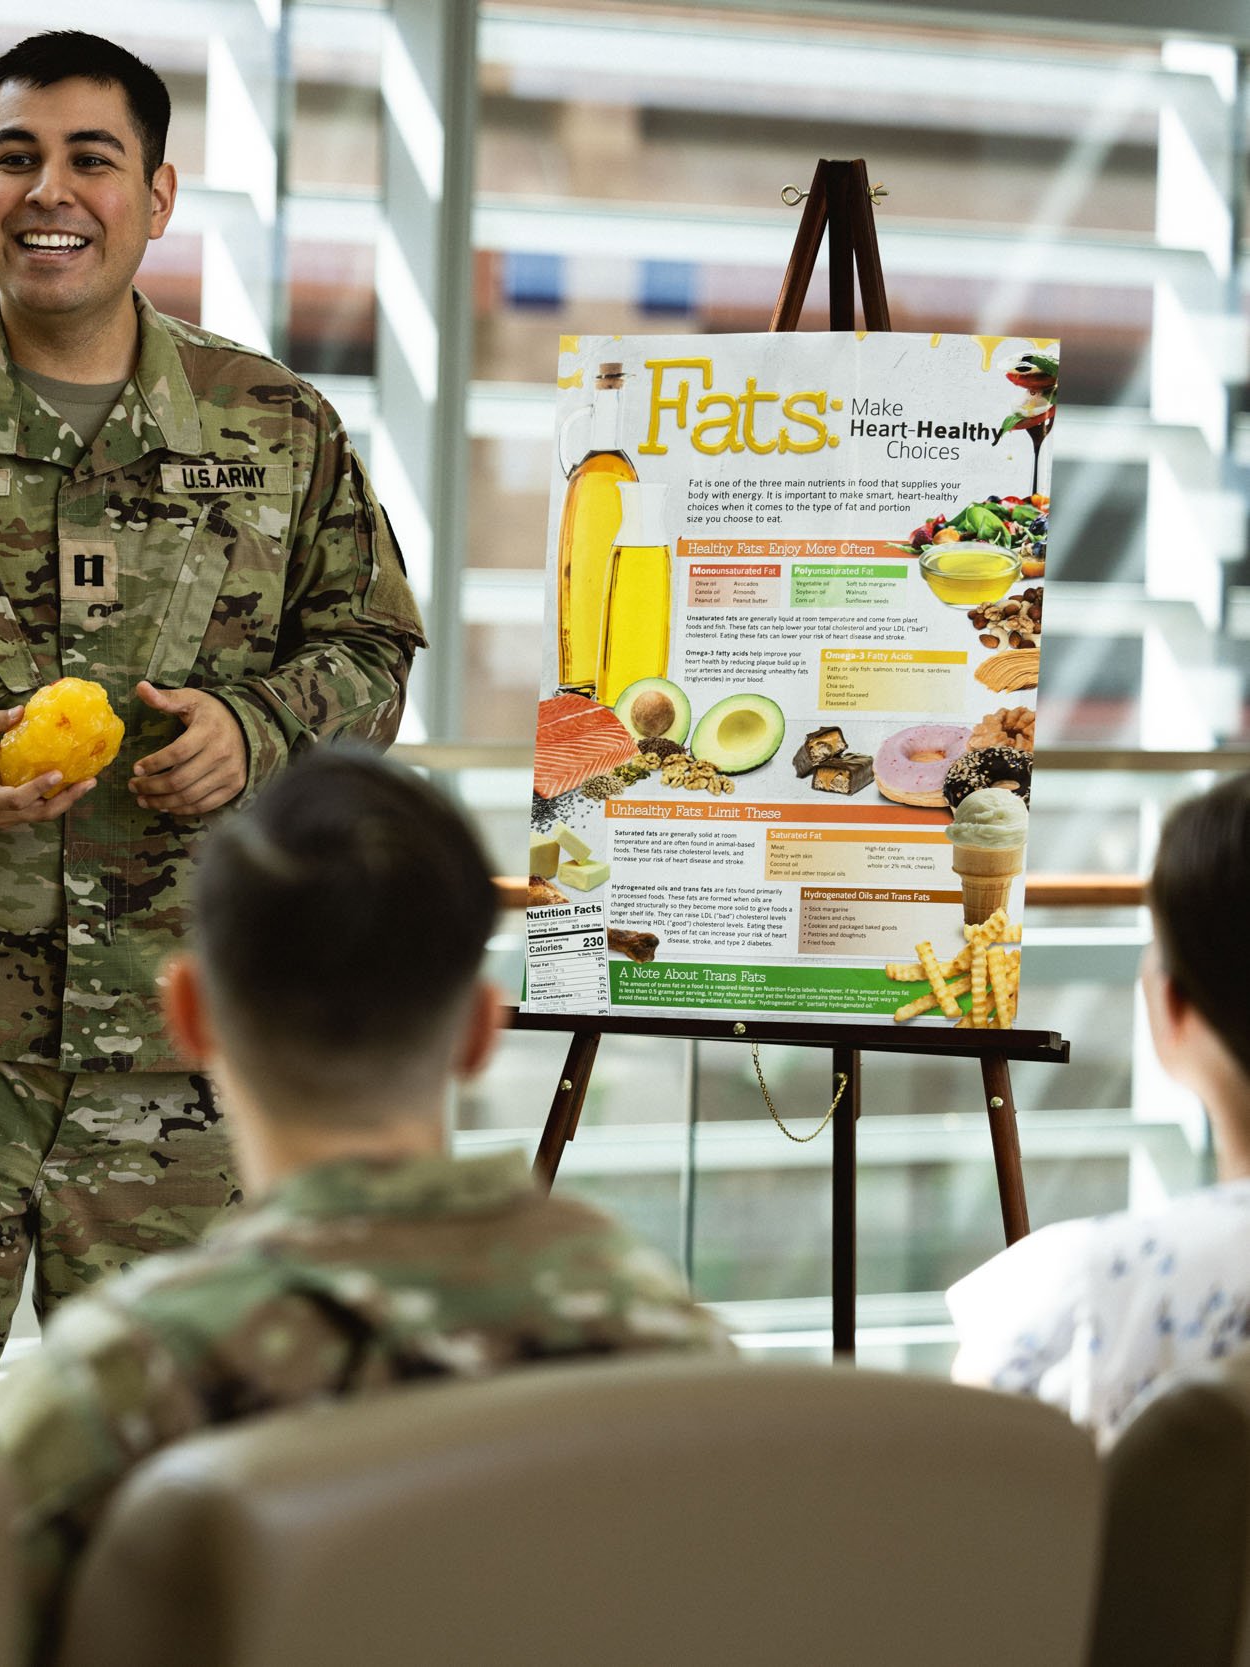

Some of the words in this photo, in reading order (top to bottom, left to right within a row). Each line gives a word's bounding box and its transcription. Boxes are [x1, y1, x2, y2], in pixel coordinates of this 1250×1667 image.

[638, 356, 842, 455] Fats:
[852, 399, 903, 416] Make
[850, 420, 1004, 446] Heart-Healthy
[887, 441, 960, 460] Choices
[689, 479, 702, 488] Fat
[705, 480, 712, 488] is
[732, 479, 741, 487] of
[744, 479, 757, 488] the
[760, 479, 782, 488] three
[784, 479, 805, 487] main
[808, 479, 846, 487] nutrients
[858, 478, 879, 487] food
[881, 480, 899, 488] that
[902, 480, 938, 489] supplies
[940, 482, 961, 491] your
[688, 491, 709, 501] body
[712, 491, 730, 500] with
[767, 491, 773, 500] It
[775, 491, 782, 499] is
[784, 491, 826, 500] important
[840, 491, 863, 499] make
[898, 492, 958, 503] heart-healthy
[687, 503, 719, 511] choices
[722, 503, 744, 511] when
[747, 502, 753, 511] it
[796, 503, 810, 511] the
[812, 504, 832, 513] type
[834, 502, 843, 511] of
[845, 502, 857, 511] fat
[860, 503, 876, 511] and
[878, 504, 910, 512] portion
[687, 515, 703, 523] size
[706, 517, 721, 525] you
[723, 515, 753, 523] choose
[756, 515, 764, 523] to
[688, 543, 734, 556] Healthy
[737, 543, 765, 554] Fats:
[769, 543, 802, 557] Enjoy
[806, 543, 836, 554] More
[840, 543, 875, 556] Often
[692, 566, 761, 574] Monounsaturated
[764, 567, 776, 575] Fat
[794, 567, 859, 576] Polyunsaturated
[862, 567, 874, 575] Fat
[825, 651, 865, 661] Omega-3
[867, 652, 888, 661] Fatty
[891, 652, 913, 660] Acids
[612, 804, 672, 819] Unhealthy
[676, 806, 704, 817] Fats:
[708, 806, 740, 818] Limit
[745, 807, 781, 819] These
[770, 831, 808, 839] Saturated
[809, 832, 822, 840] Fat
[804, 890, 856, 900] Hydrogenated
[858, 891, 873, 900] Oils
[875, 892, 888, 900] and
[891, 892, 912, 901] Trans
[914, 893, 930, 901] Fats
[526, 908, 571, 920] Nutrition
[574, 904, 602, 915] Facts
[583, 936, 604, 947] 230
[529, 944, 563, 953] Calories
[619, 967, 628, 978] A
[632, 967, 660, 979] Note
[664, 968, 698, 980] About
[703, 969, 736, 982] Trans
[741, 971, 766, 983] Fats
